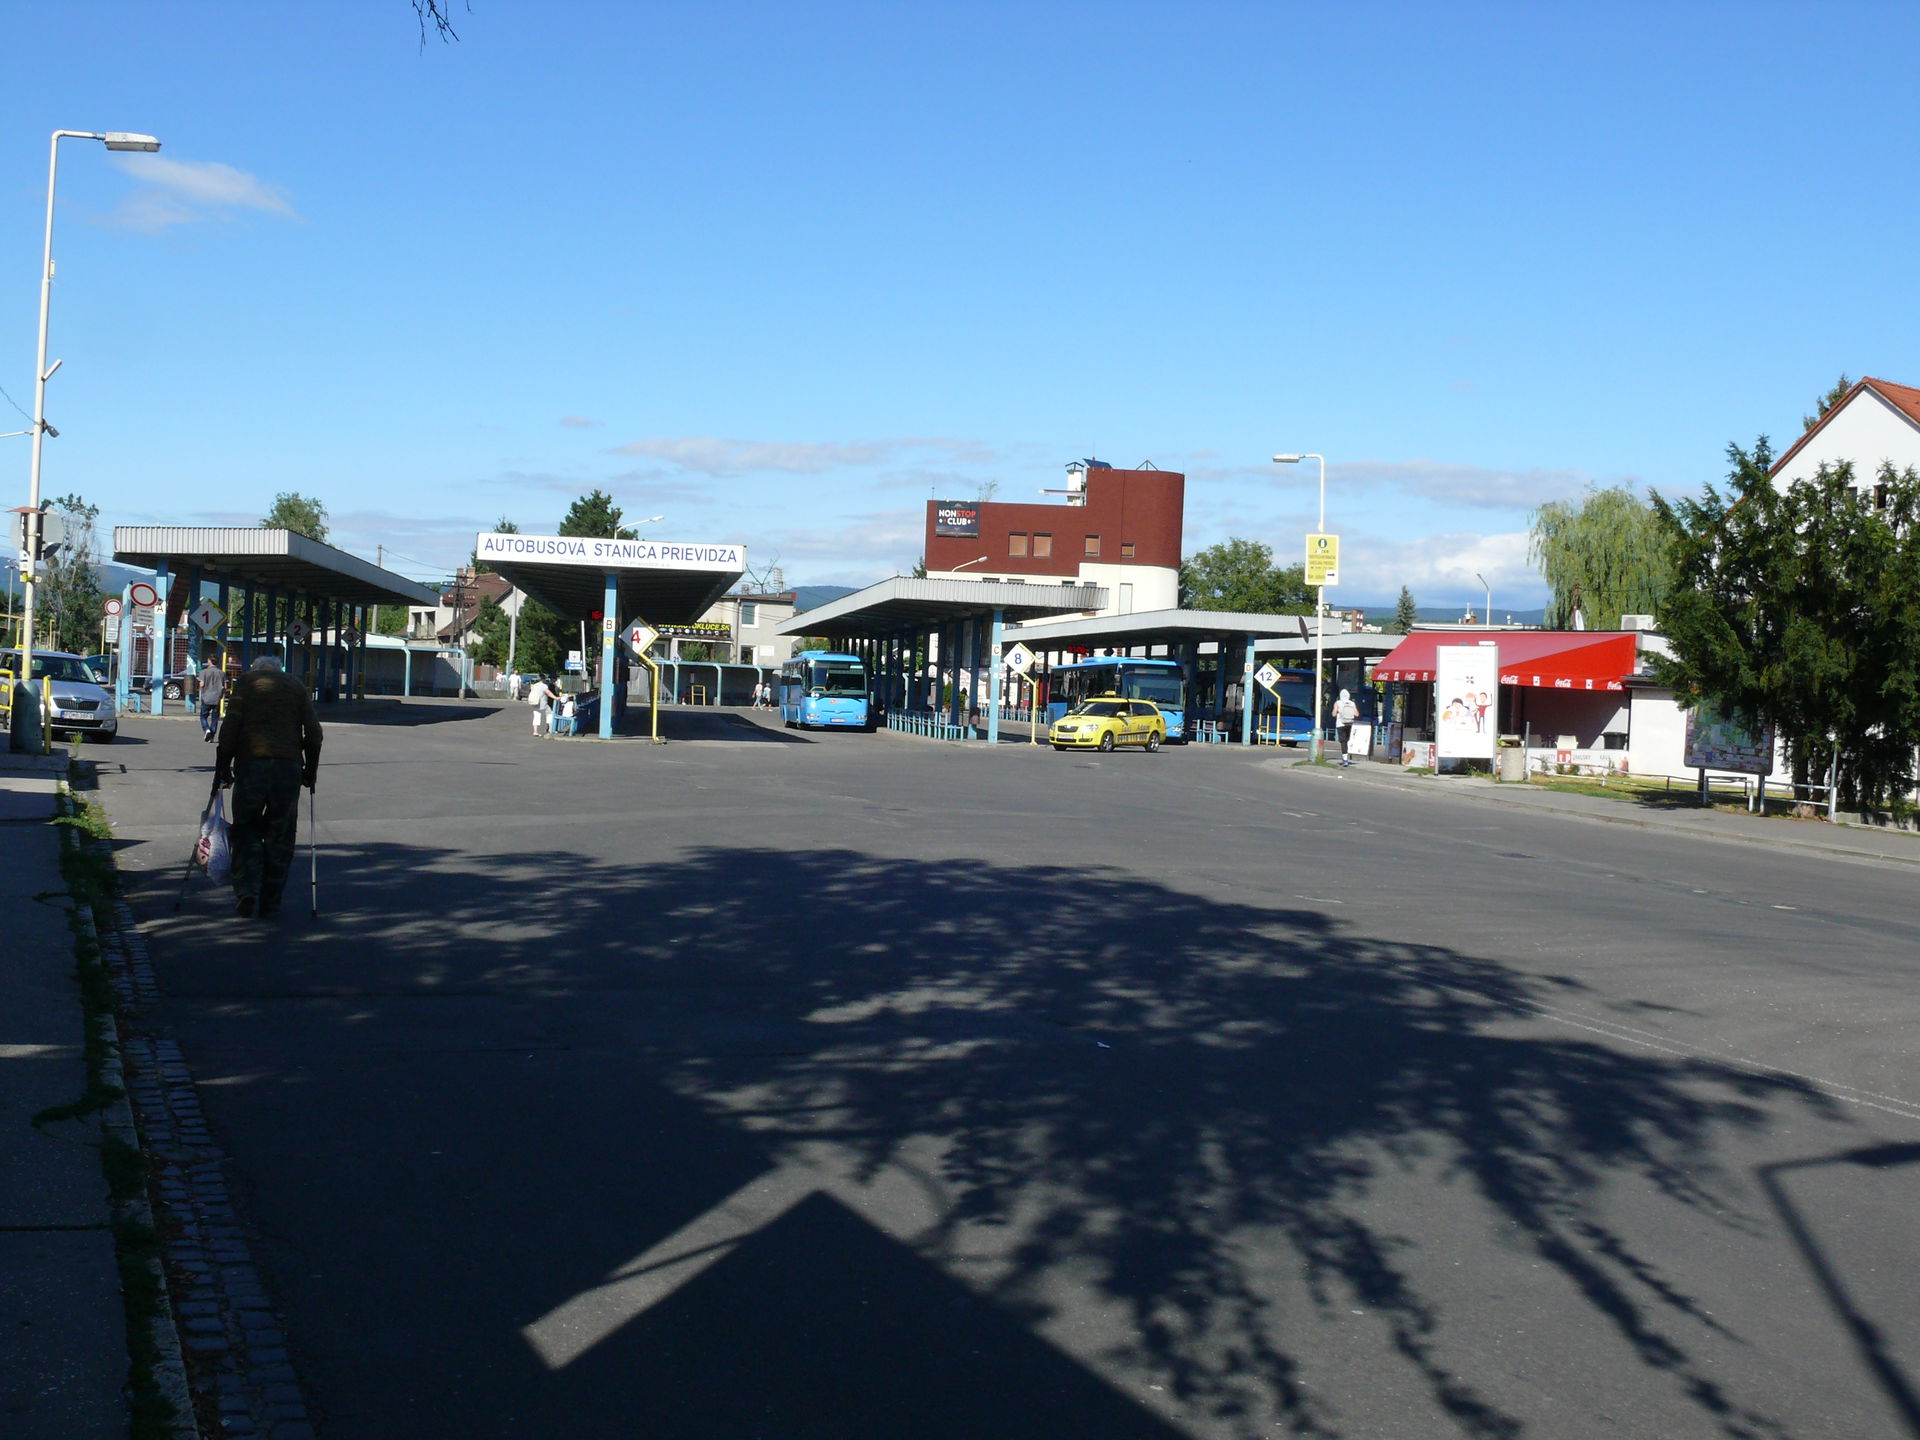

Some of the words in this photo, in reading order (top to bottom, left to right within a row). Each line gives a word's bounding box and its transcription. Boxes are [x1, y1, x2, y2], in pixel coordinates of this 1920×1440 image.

[939, 510, 976, 518] NONSTOP
[484, 538, 586, 556] AUTOBUSOVÁ
[594, 543, 657, 559] STANICA
[661, 548, 737, 563] PRIEVIDZA
[202, 610, 209, 624] 1
[294, 624, 301, 636] 2
[606, 619, 613, 630] B
[631, 630, 641, 644] 4
[994, 646, 1000, 655] C
[1014, 653, 1022, 665] 8
[1260, 672, 1272, 681] 12
